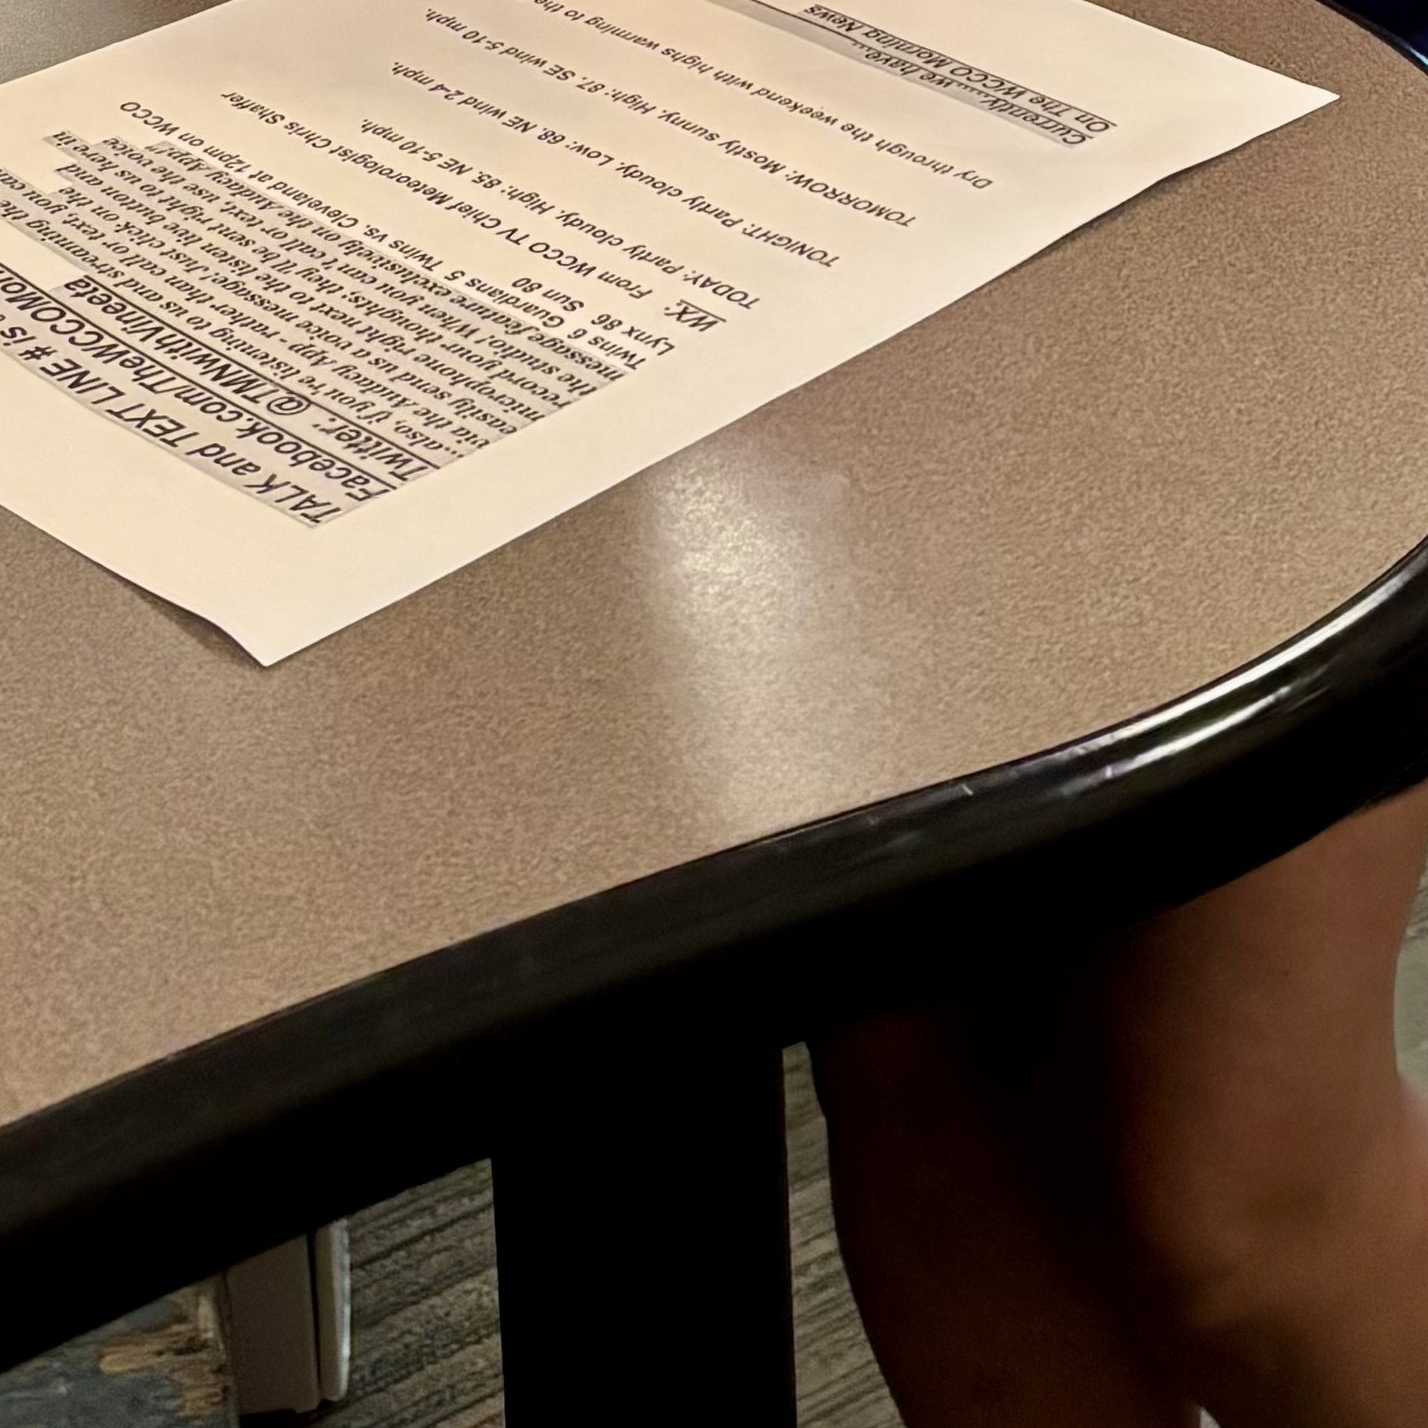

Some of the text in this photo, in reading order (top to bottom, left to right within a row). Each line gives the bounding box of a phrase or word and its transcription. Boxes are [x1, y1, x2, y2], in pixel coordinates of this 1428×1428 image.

[558, 9, 587, 20] to
[580, 15, 666, 51] warming
[654, 46, 718, 73] highs
[707, 70, 756, 90] with
[797, 5, 1113, 133] On The WCCO Morning News
[414, 7, 921, 227] TOMORROW: Mostly sunny. High: 87. SE wind 5-10 mph.
[749, 87, 841, 126] weekend
[834, 122, 876, 142] the
[381, 60, 843, 266] TONIGHT: Partly cloudy. Low: 68. NE wind 2-4 mph.
[869, 137, 959, 174] through
[21, 187, 70, 214] you
[201, 168, 289, 213] Audacy
[948, 168, 998, 189] Dry
[53, 211, 112, 242] text,
[215, 90, 722, 333] WX: From WCCO TV Chief Meteorologist Chris Shaffer
[349, 117, 763, 309] TODAY: Partly cloudy. High: 85. NE 5-10 mph.
[18, 217, 132, 281] streaming
[115, 100, 650, 369] Twins 6 Guardians 5 Twins vs. Cleveland at 12pm on WCCO
[67, 143, 572, 411] record your thoughts; they'll sent right here
[95, 136, 598, 397] the studio! When you can't call text, voice
[121, 253, 170, 278] call
[333, 238, 459, 299] exclusively
[51, 186, 524, 437] easily send voice message! Just click the
[56, 162, 551, 424] microphone right next listen live button and
[114, 277, 166, 304] and
[159, 275, 217, 305] than
[204, 300, 280, 340] rather
[443, 294, 537, 338] feature
[507, 276, 681, 355] Lynx 86 Sun 80
[18, 341, 58, 363] #
[202, 325, 307, 379] listening
[283, 340, 346, 369] App
[527, 329, 629, 380] message
[38, 356, 127, 405] LINE
[55, 276, 430, 481] Twitter: @TMNwithVineeta
[291, 372, 377, 415] you're
[328, 360, 424, 411] Audacy
[106, 397, 202, 447] TEXT
[407, 406, 455, 431] the
[443, 425, 490, 450] via
[186, 439, 265, 480] and
[244, 471, 343, 524] TALK
